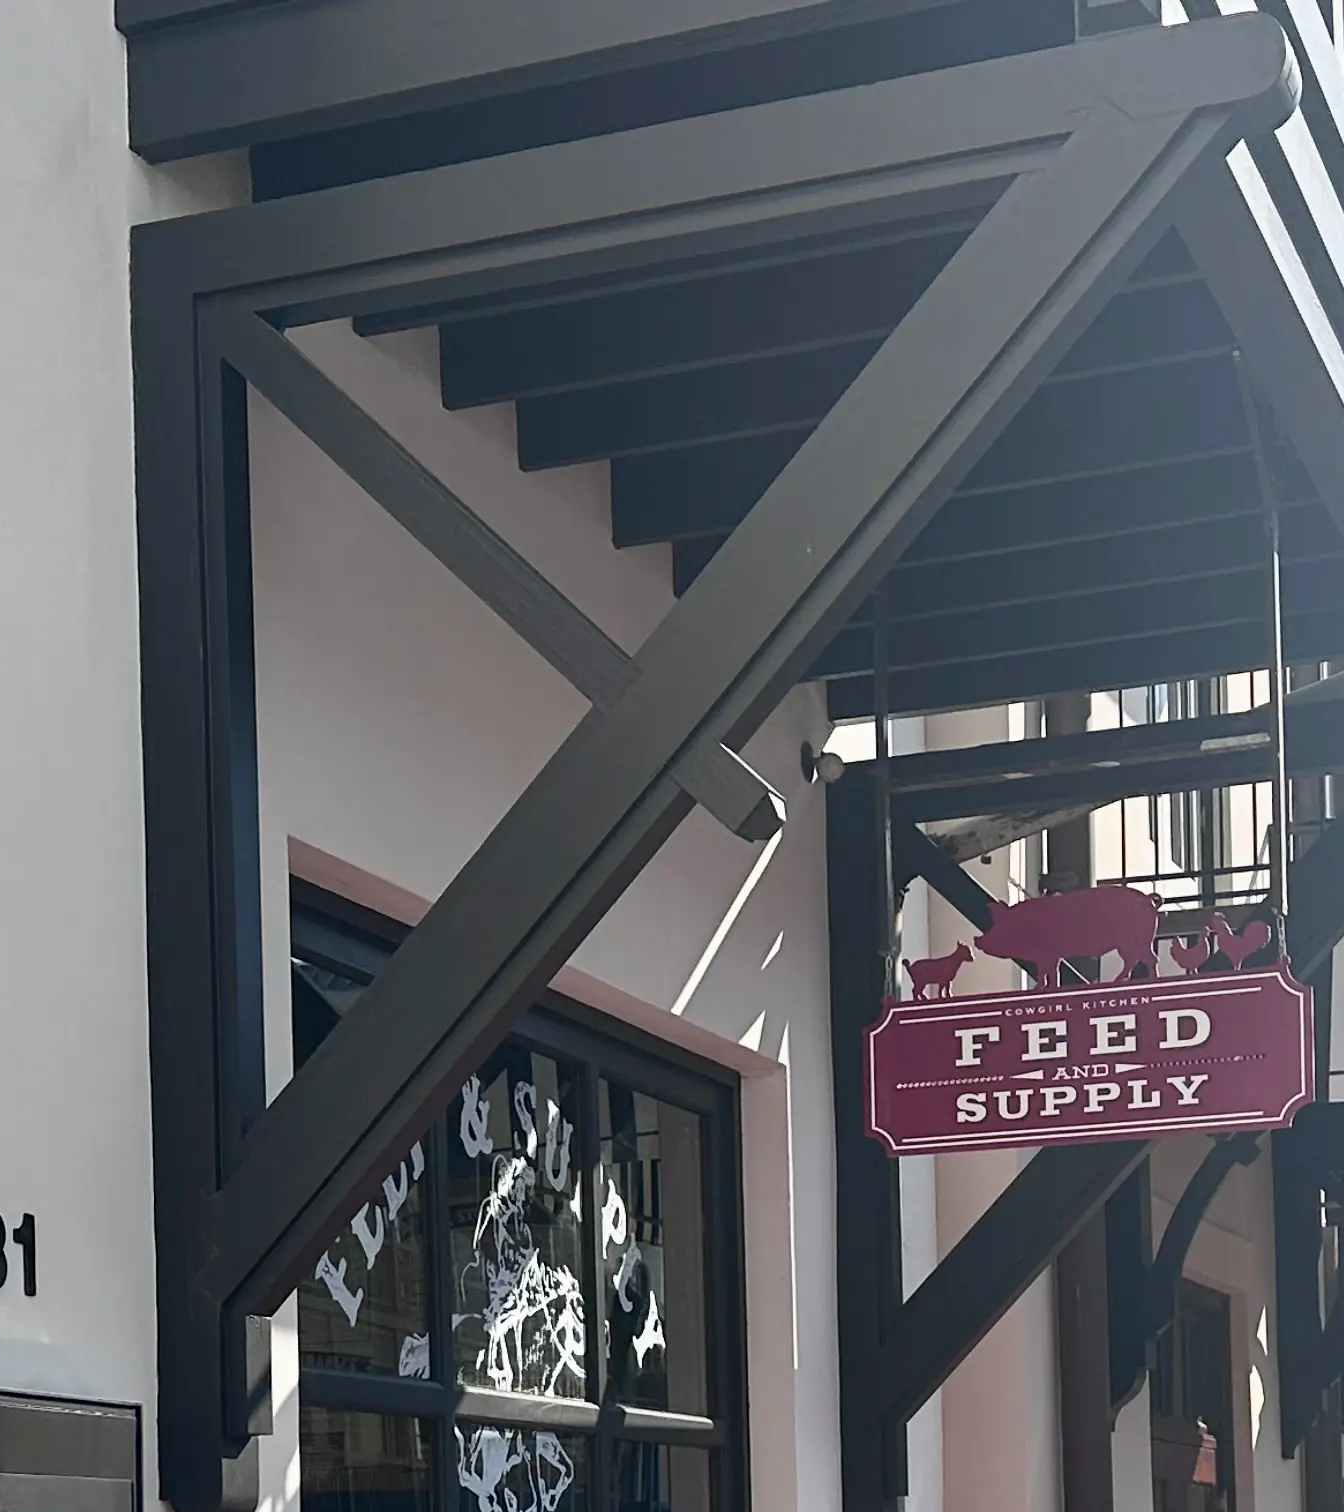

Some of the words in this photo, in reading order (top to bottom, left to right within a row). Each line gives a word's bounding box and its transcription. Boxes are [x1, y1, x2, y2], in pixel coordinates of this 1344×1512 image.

[1005, 1003, 1073, 1017] COWGIRL
[1083, 997, 1150, 1010] KITCHEN
[954, 1008, 1211, 1067] FEED
[1052, 1064, 1109, 1080] AND
[956, 1074, 1209, 1123] SUPPLY
